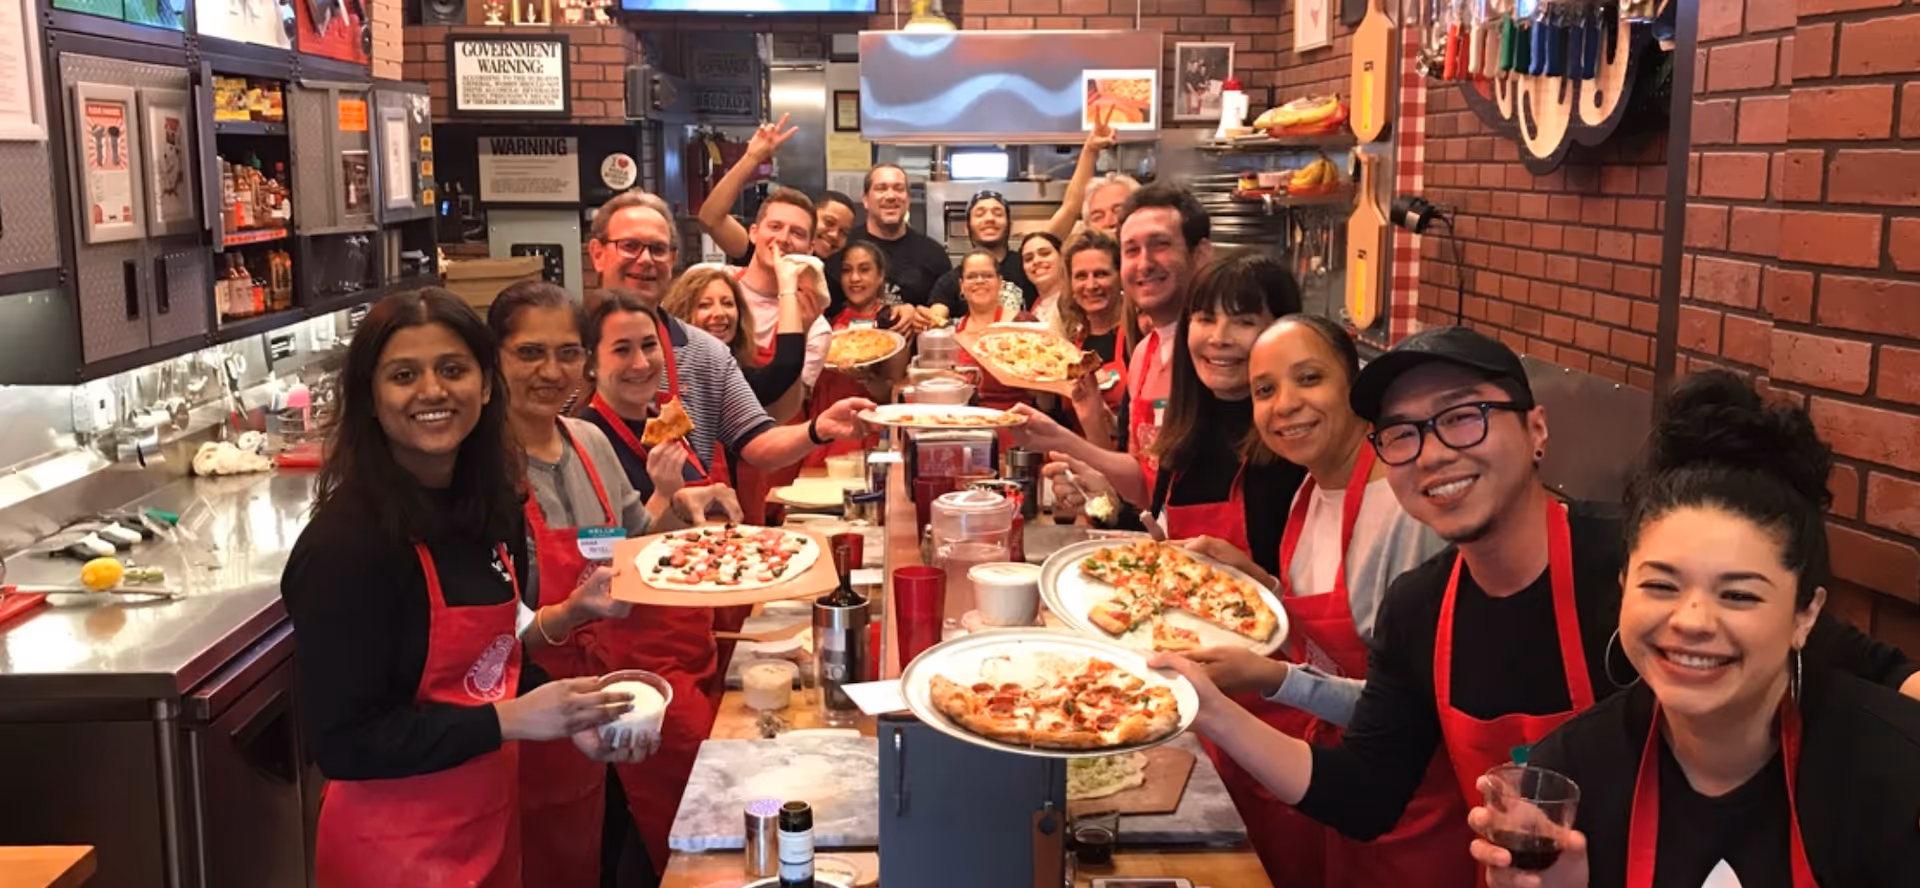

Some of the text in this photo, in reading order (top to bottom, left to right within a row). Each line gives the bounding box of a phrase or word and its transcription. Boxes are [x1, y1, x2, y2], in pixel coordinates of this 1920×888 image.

[462, 41, 558, 58] GOVERNMENT
[477, 59, 544, 74] WARNING:
[491, 138, 567, 156] WARNING
